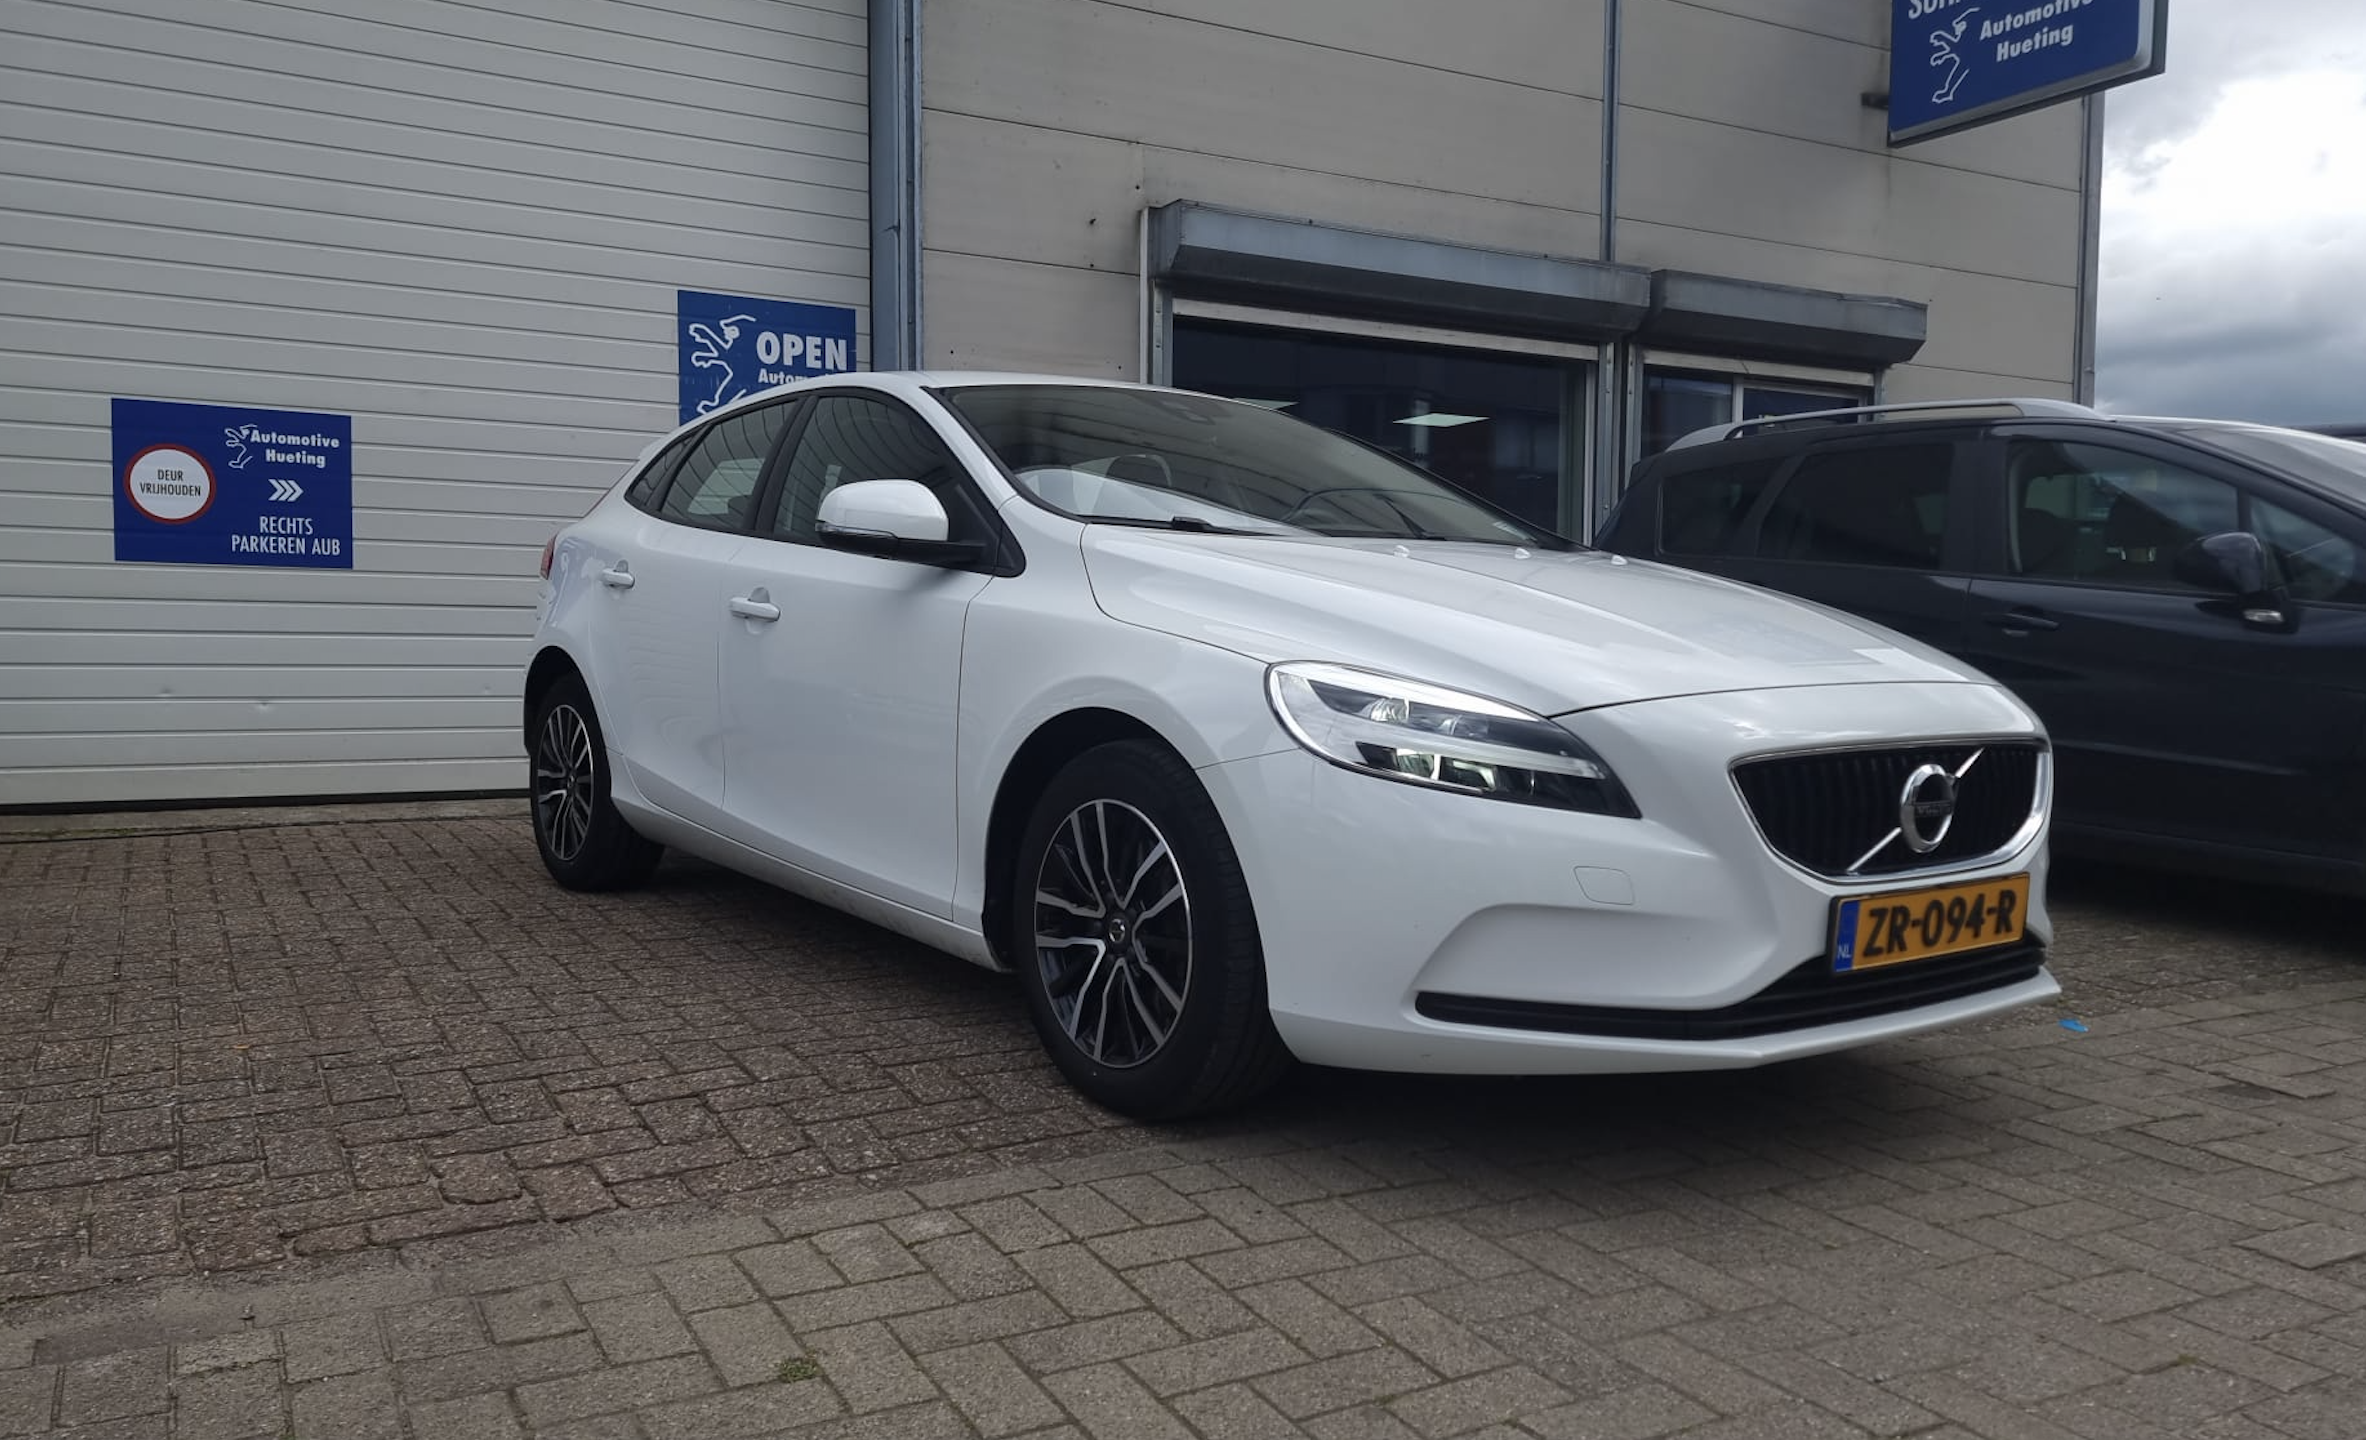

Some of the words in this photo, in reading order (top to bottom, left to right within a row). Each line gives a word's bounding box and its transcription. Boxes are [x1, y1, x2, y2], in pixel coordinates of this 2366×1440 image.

[1996, 24, 2074, 62] Hueting
[756, 331, 848, 371] OPEN
[250, 429, 340, 448] Automotive
[265, 448, 326, 468] Hueting
[157, 469, 184, 482] DEUR
[140, 482, 202, 497] VRIJHOUDEN
[259, 516, 314, 535] RECHTS
[231, 534, 306, 554] PARKEREN
[311, 538, 341, 555] AUB
[1862, 889, 2017, 957] ZR-094-R
[1837, 944, 1852, 960] NL
